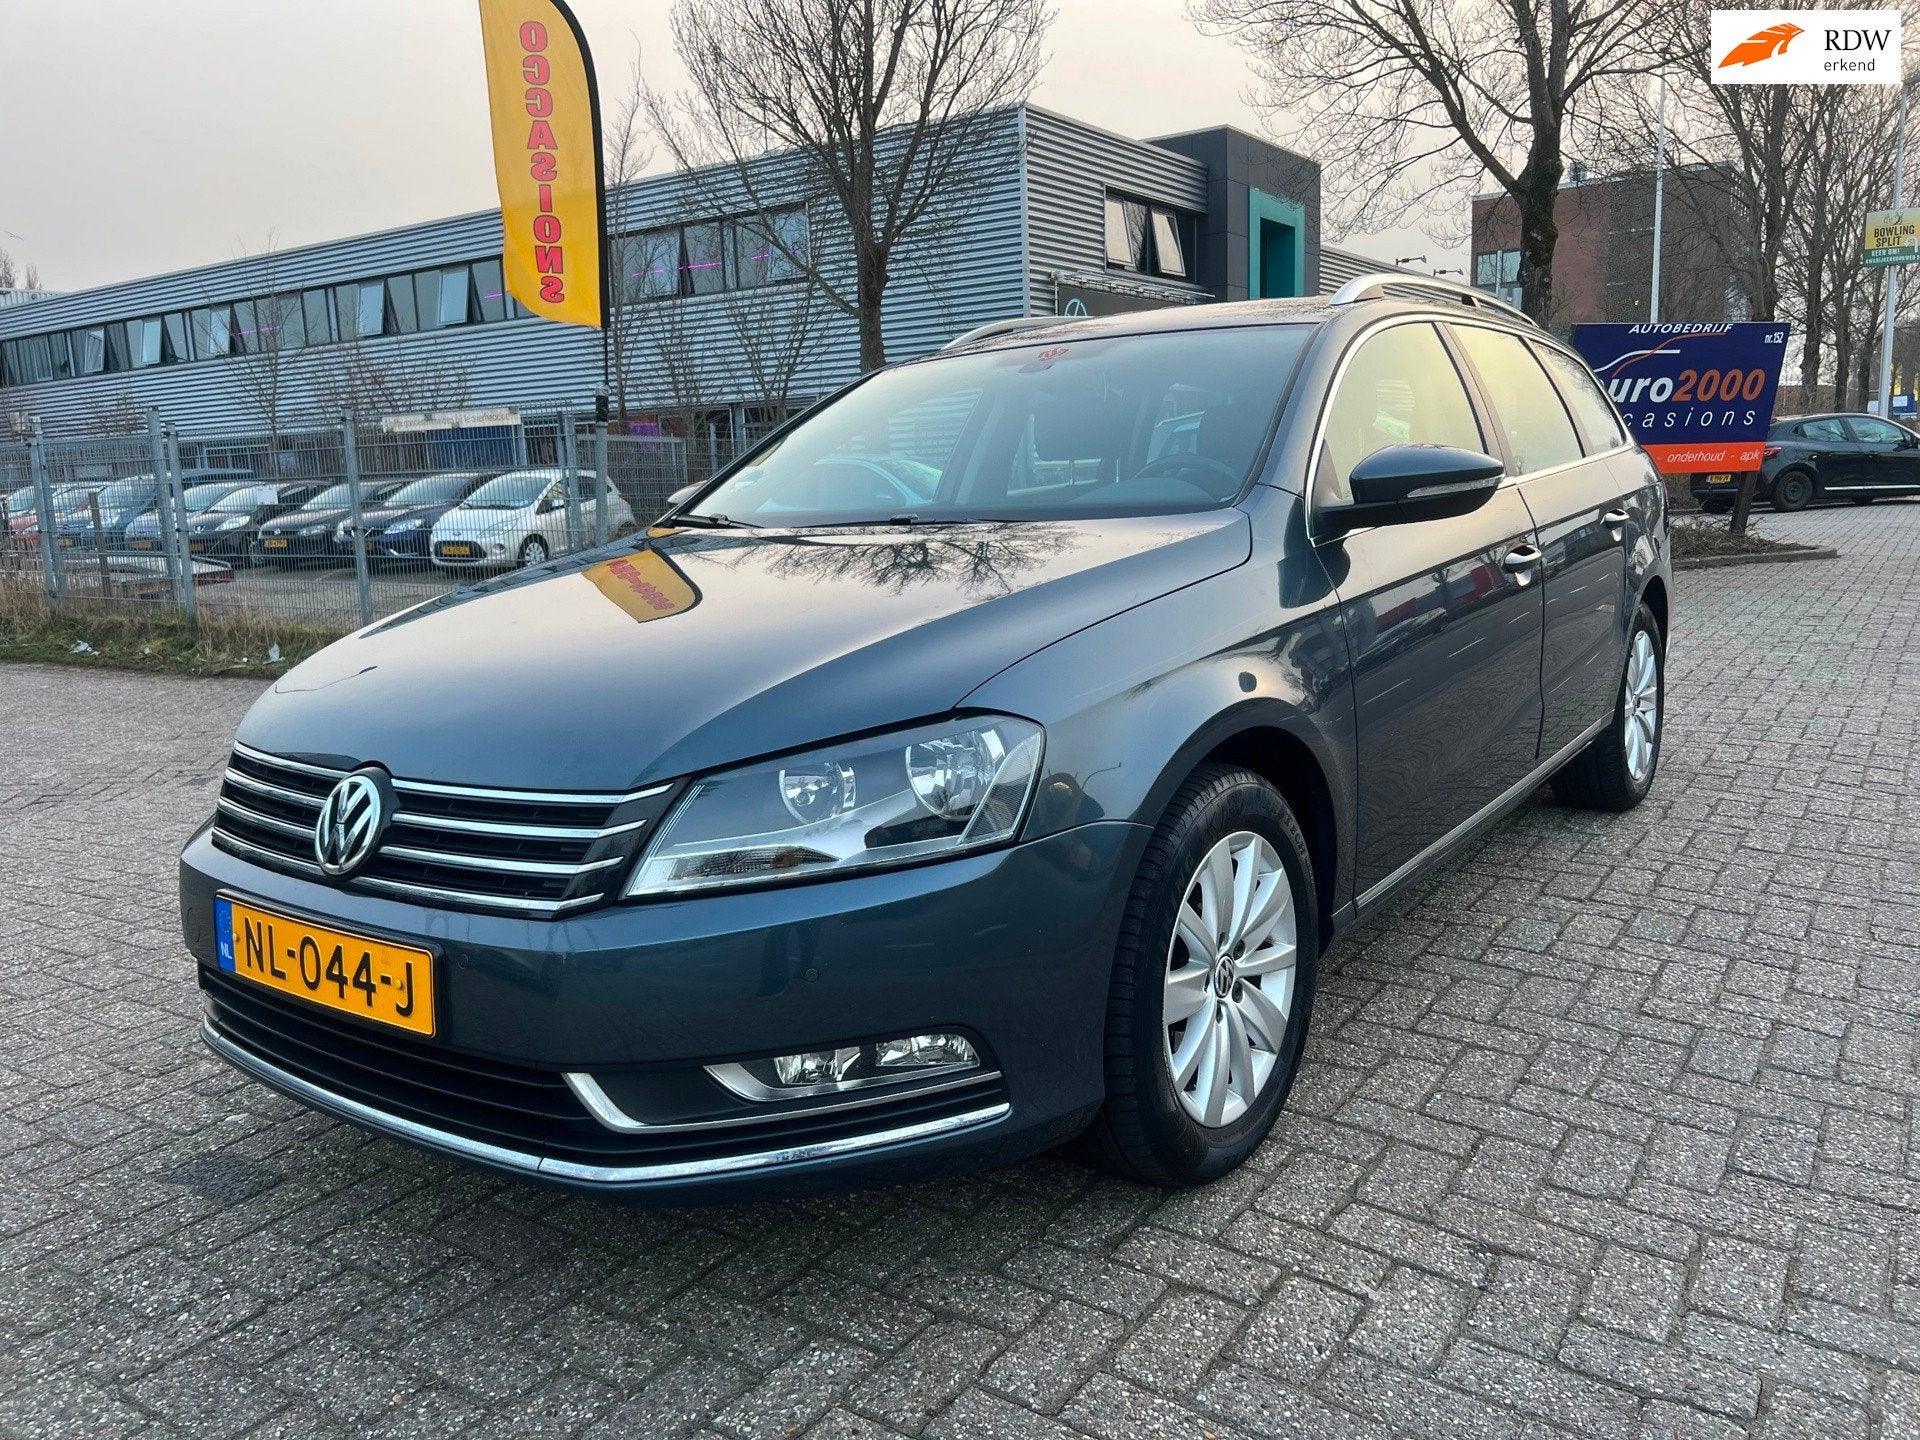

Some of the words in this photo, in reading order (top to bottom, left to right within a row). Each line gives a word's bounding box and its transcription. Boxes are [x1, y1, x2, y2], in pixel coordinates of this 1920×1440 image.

[1874, 225, 1915, 238] BOWLING
[1875, 236, 1902, 248] SPLIT
[1628, 323, 1734, 334] AUTOBEDRIJF
[1600, 368, 1766, 403] uro2000
[1623, 408, 1755, 428] casions
[1667, 450, 1726, 463] onderhoud
[1740, 449, 1761, 462] apk
[220, 941, 233, 960] NL
[244, 916, 414, 1018] NL-044-J
